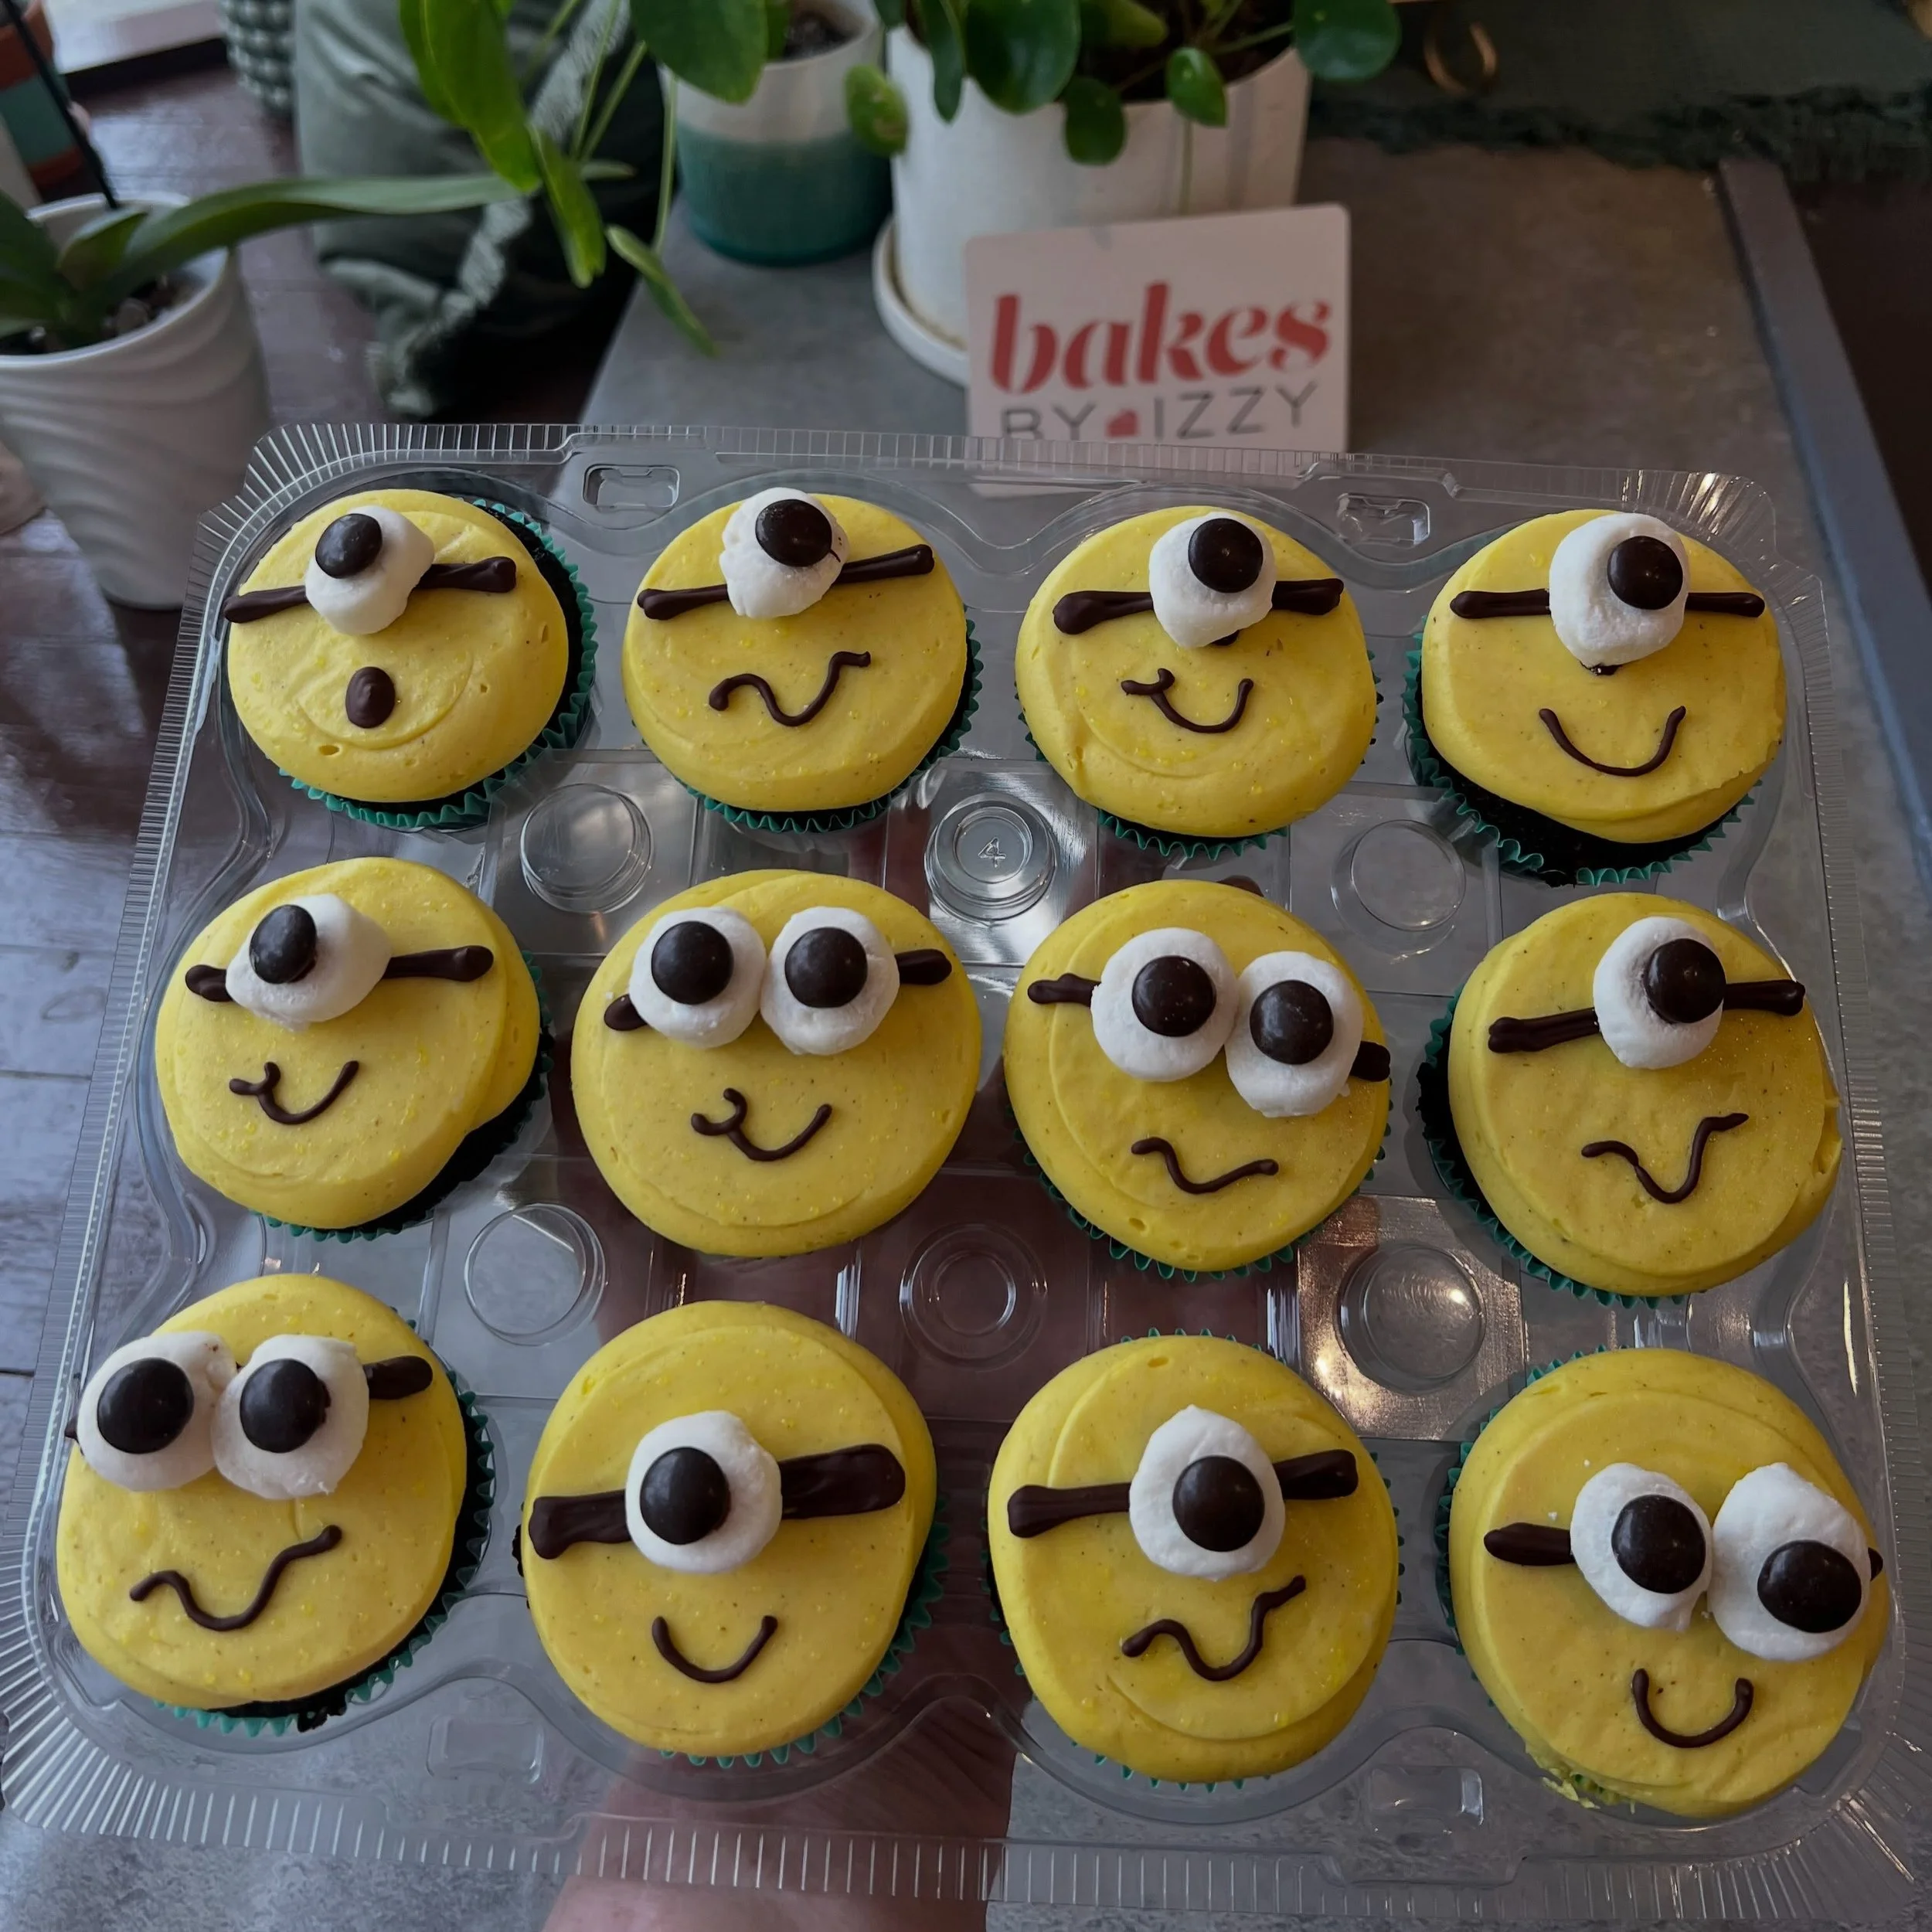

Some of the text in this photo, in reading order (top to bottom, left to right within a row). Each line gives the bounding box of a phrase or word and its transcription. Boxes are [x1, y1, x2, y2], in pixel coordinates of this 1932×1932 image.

[991, 281, 1332, 394] bakes
[1002, 381, 1318, 440] BY IZZY
[978, 837, 1006, 869] 4
